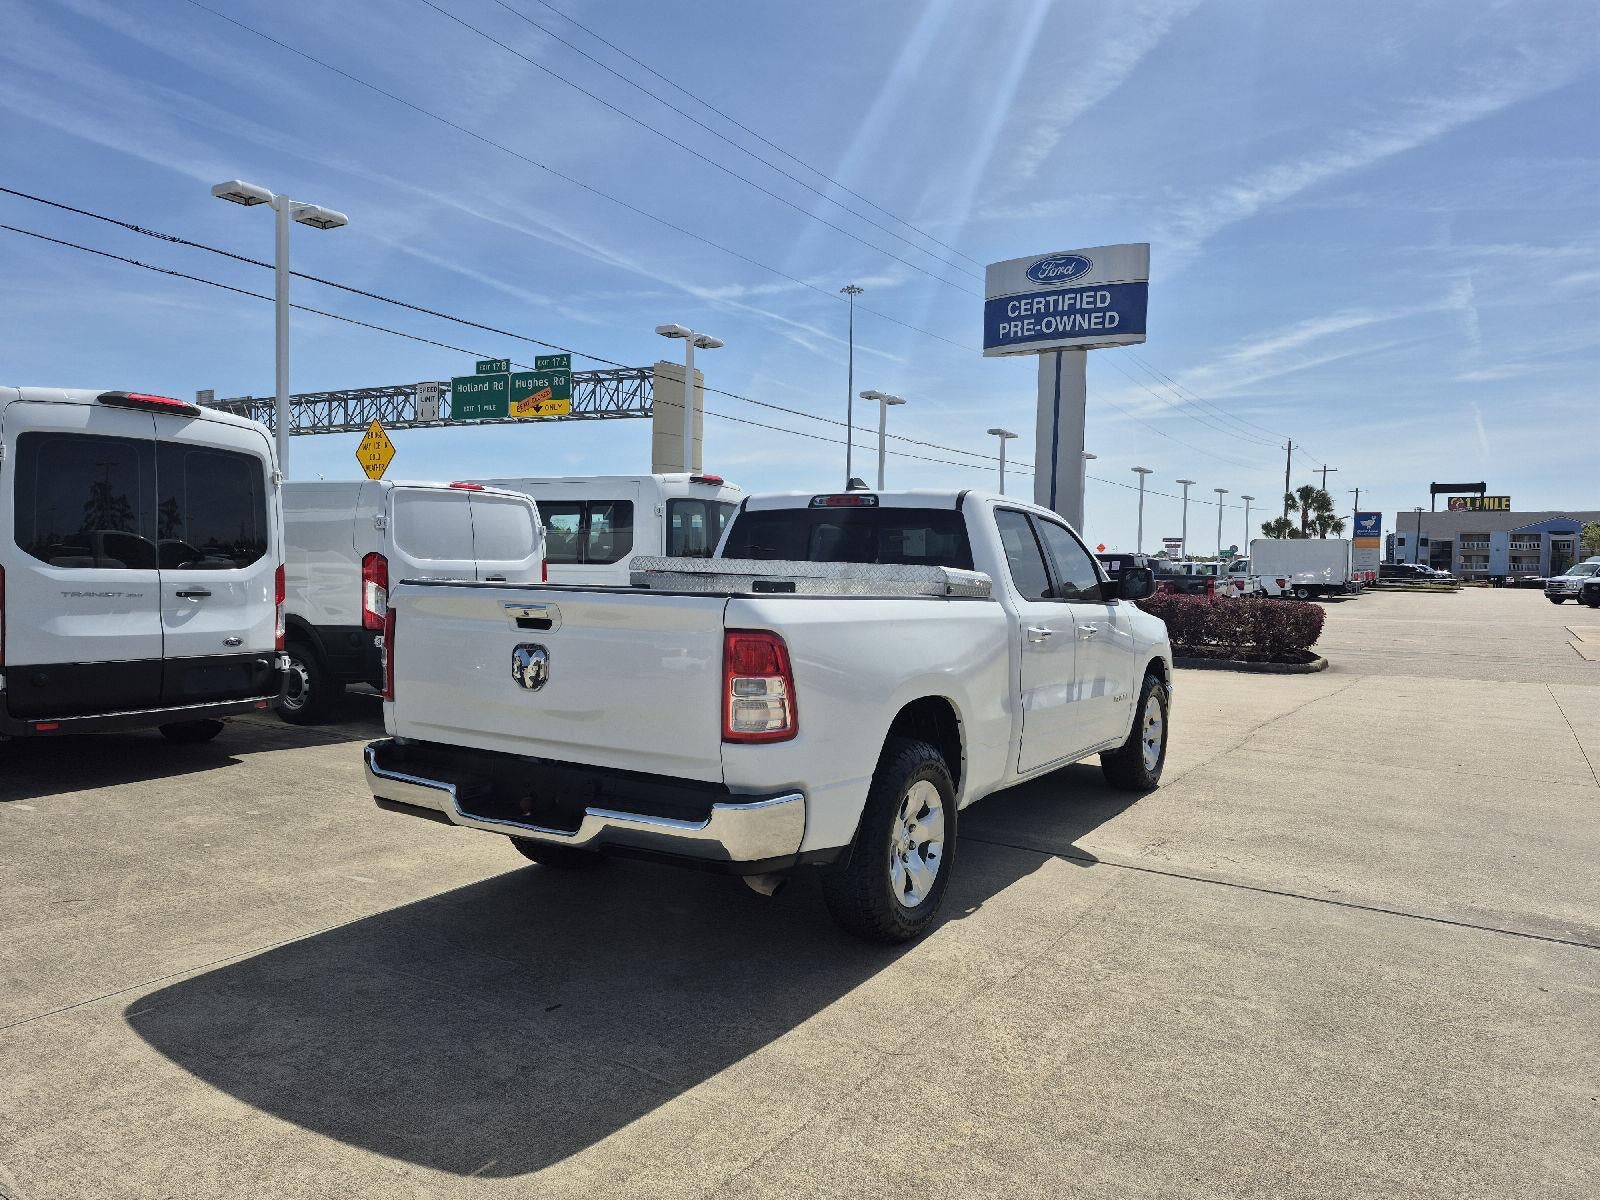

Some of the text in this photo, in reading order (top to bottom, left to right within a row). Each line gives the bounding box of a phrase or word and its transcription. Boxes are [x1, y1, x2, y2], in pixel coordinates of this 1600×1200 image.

[1037, 259, 1076, 279] Ford
[1007, 291, 1111, 318] CERTIFIED
[999, 311, 1120, 339] PRE-OWNED
[537, 359, 549, 367] EXIT
[457, 380, 504, 393] Holland Rd
[515, 376, 565, 390] Hughes Rd
[420, 395, 436, 403] LIMIT
[544, 403, 563, 411] ONLY
